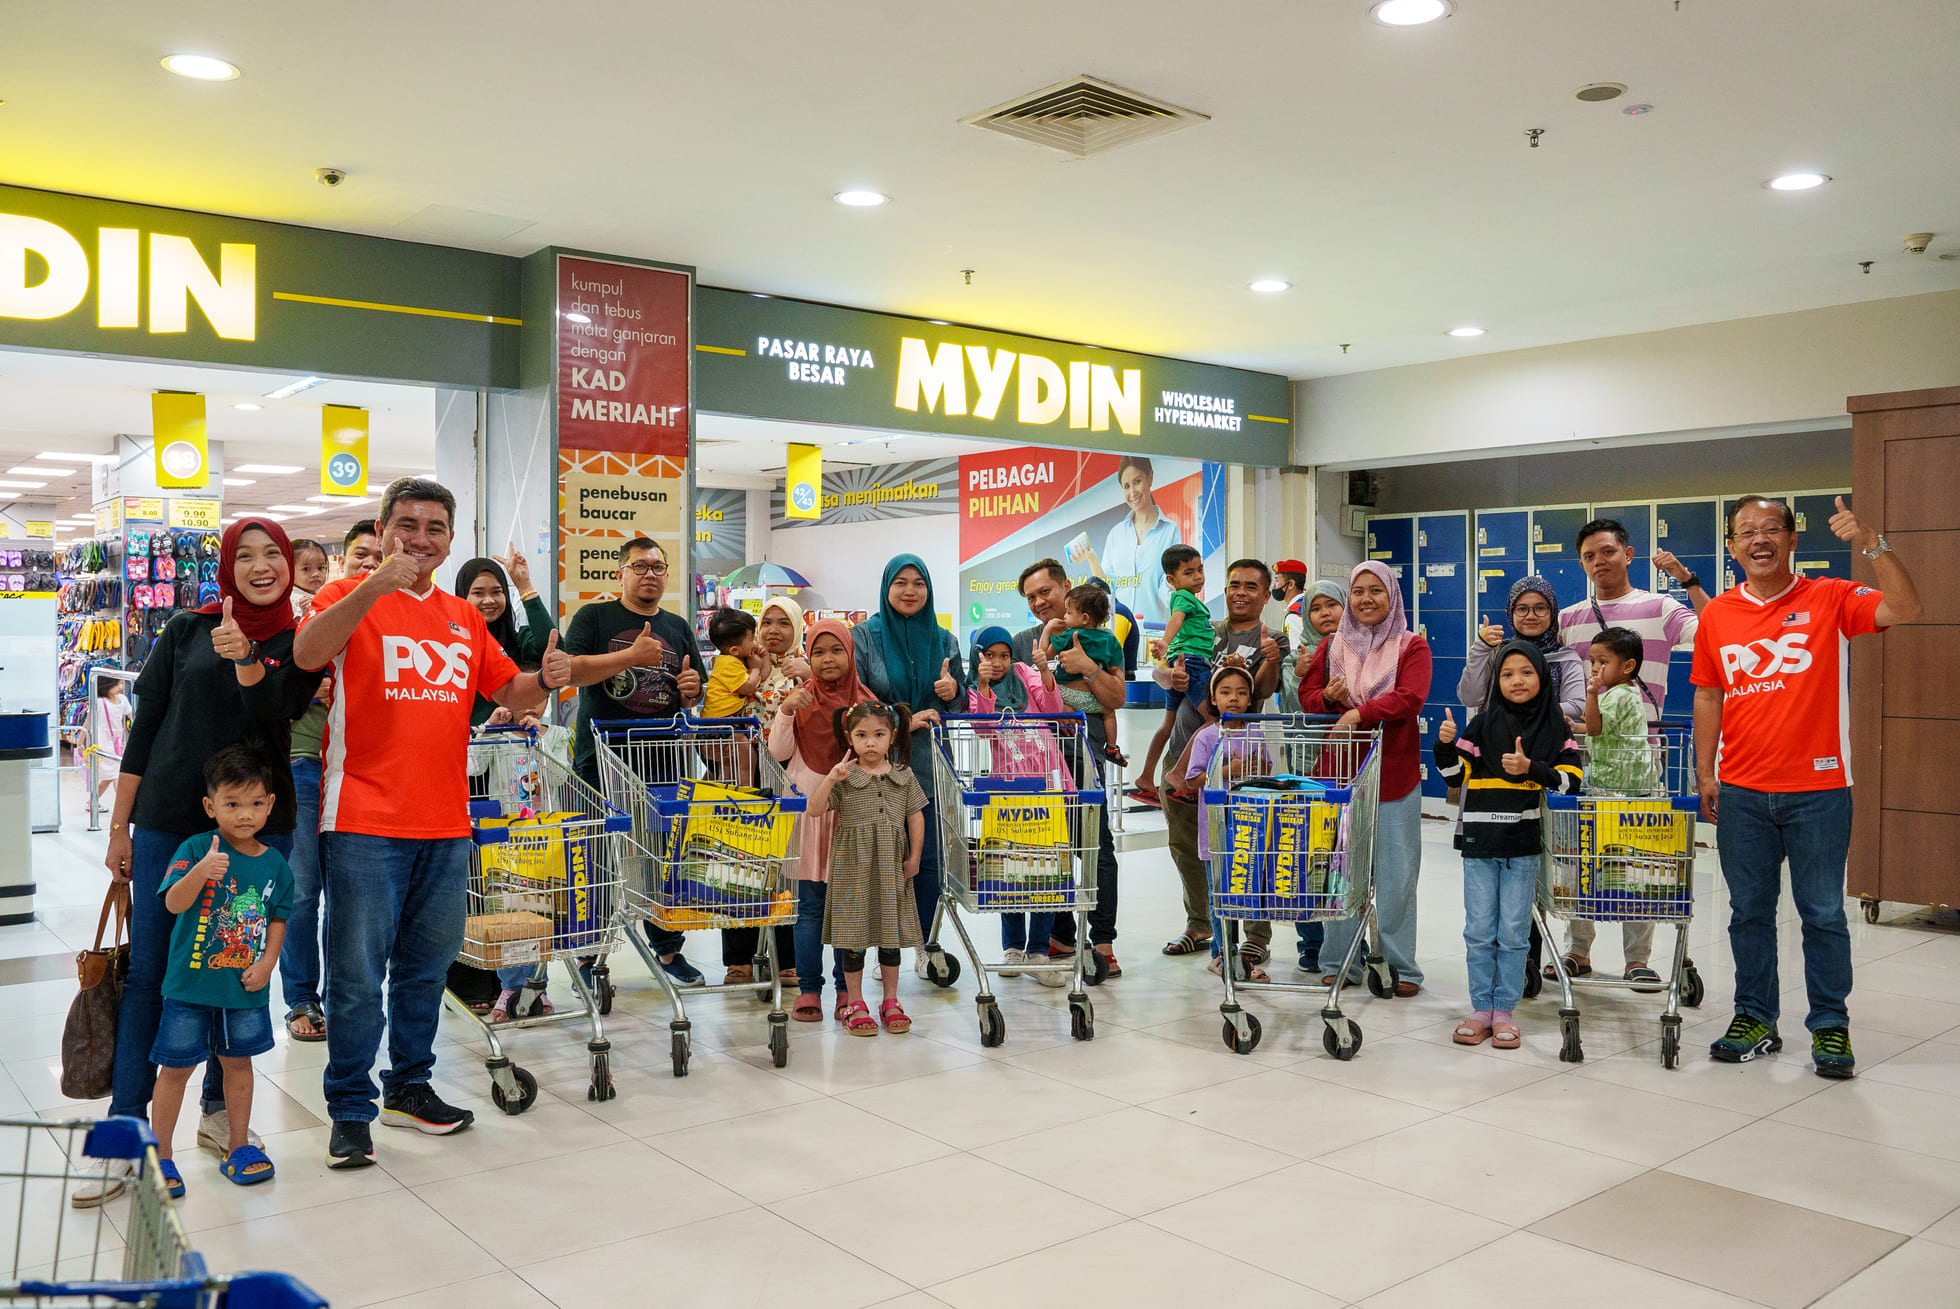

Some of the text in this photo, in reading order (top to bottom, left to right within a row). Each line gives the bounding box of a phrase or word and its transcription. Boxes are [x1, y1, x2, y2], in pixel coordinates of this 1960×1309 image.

[571, 272, 623, 298] kumpul
[571, 296, 642, 320] dan tebus
[571, 322, 676, 346] mata ganjaran
[571, 340, 626, 364] dengan
[758, 336, 875, 369] PASAR RAYA
[571, 367, 626, 392] KAD
[789, 361, 846, 386] BESAR
[894, 336, 1142, 436] MYDIN
[571, 398, 676, 428] MERIAH!
[1161, 390, 1235, 415] WHOLESALE
[1154, 407, 1242, 432] HYPERMARKET
[331, 461, 357, 478] 39
[969, 461, 1055, 491] PELBAGAI
[580, 485, 667, 502] penebusan
[843, 478, 938, 509] menjimatkan
[969, 492, 1040, 518] PILIHAN
[182, 519, 209, 527] 10.90
[183, 510, 206, 518] 9.90
[580, 503, 636, 520] baucar
[580, 546, 623, 564] pene
[970, 579, 995, 594] Enjoy
[1115, 573, 1142, 588] card!
[382, 635, 473, 690] POS
[1719, 632, 1813, 686] POS
[385, 688, 459, 704] MALAYSIA
[997, 807, 1050, 821] MYDIN
[1619, 812, 1674, 827] MYDIN
[1229, 825, 1252, 894] MYDIN
[1275, 827, 1295, 899] MYDIN
